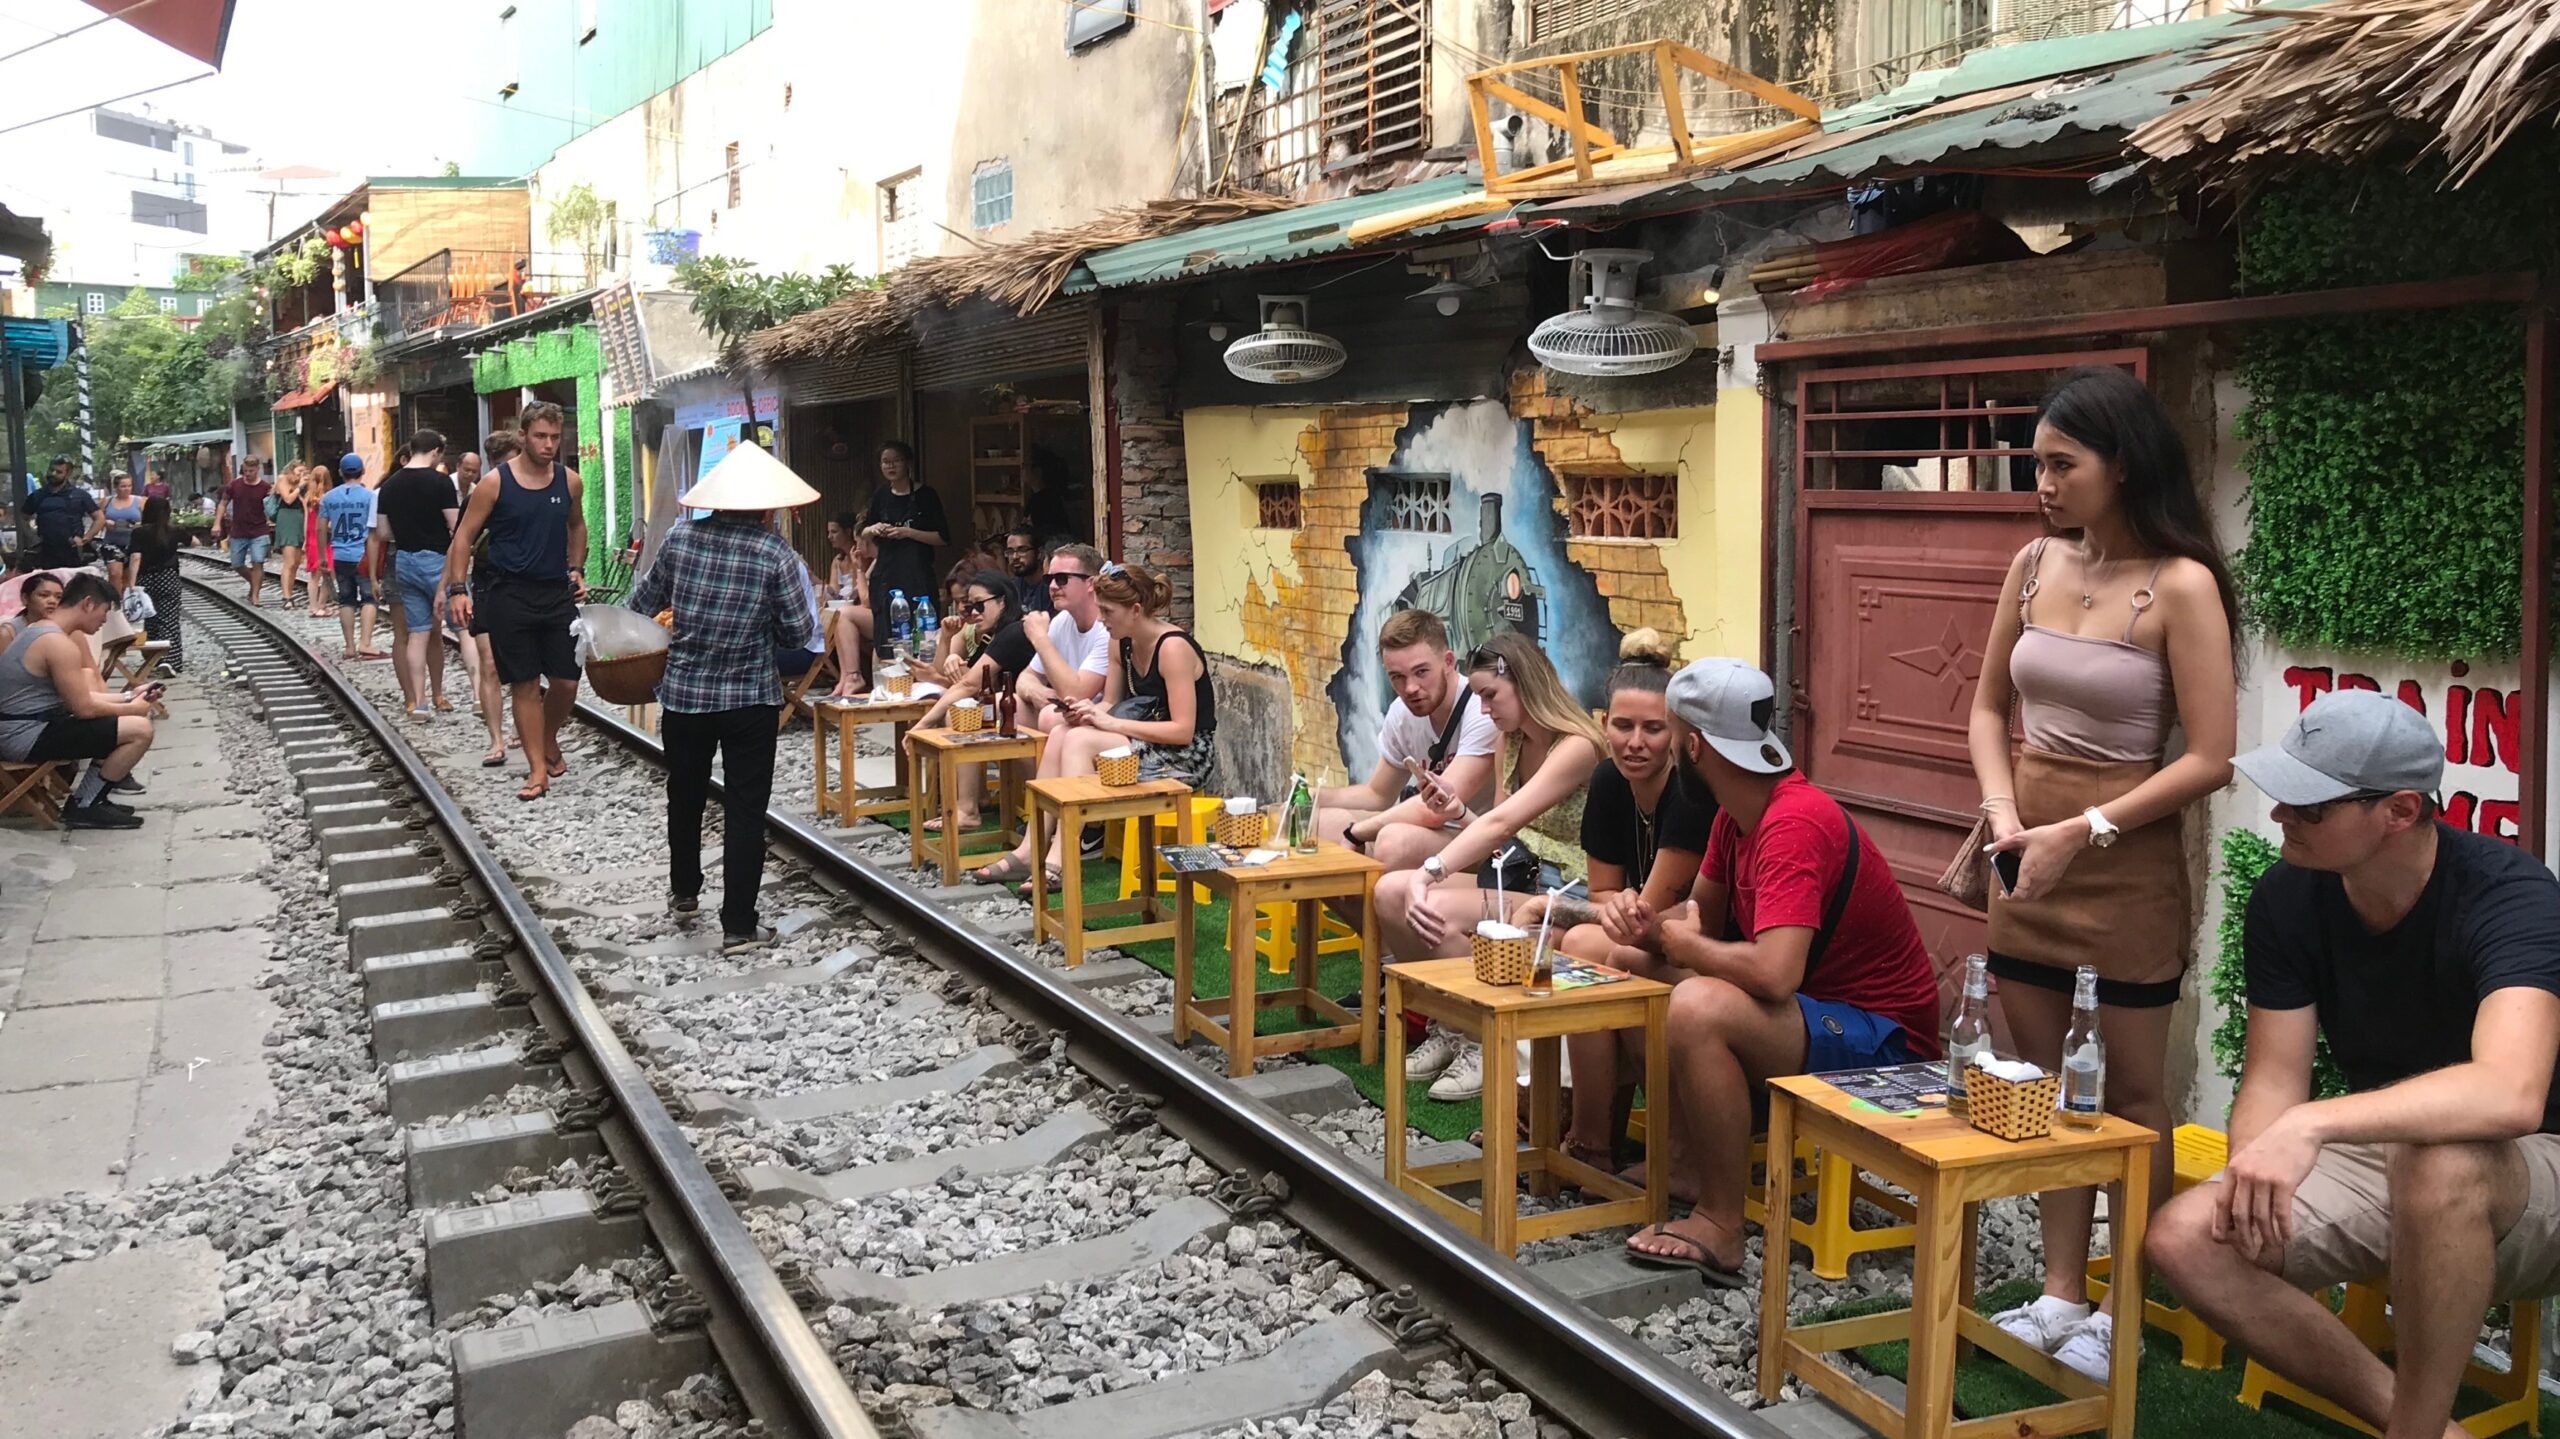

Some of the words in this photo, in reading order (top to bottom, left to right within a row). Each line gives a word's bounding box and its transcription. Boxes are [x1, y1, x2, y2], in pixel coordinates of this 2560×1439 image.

[727, 399, 756, 416] BOOKIG
[758, 396, 778, 413] OFFIC
[334, 513, 363, 542] 45
